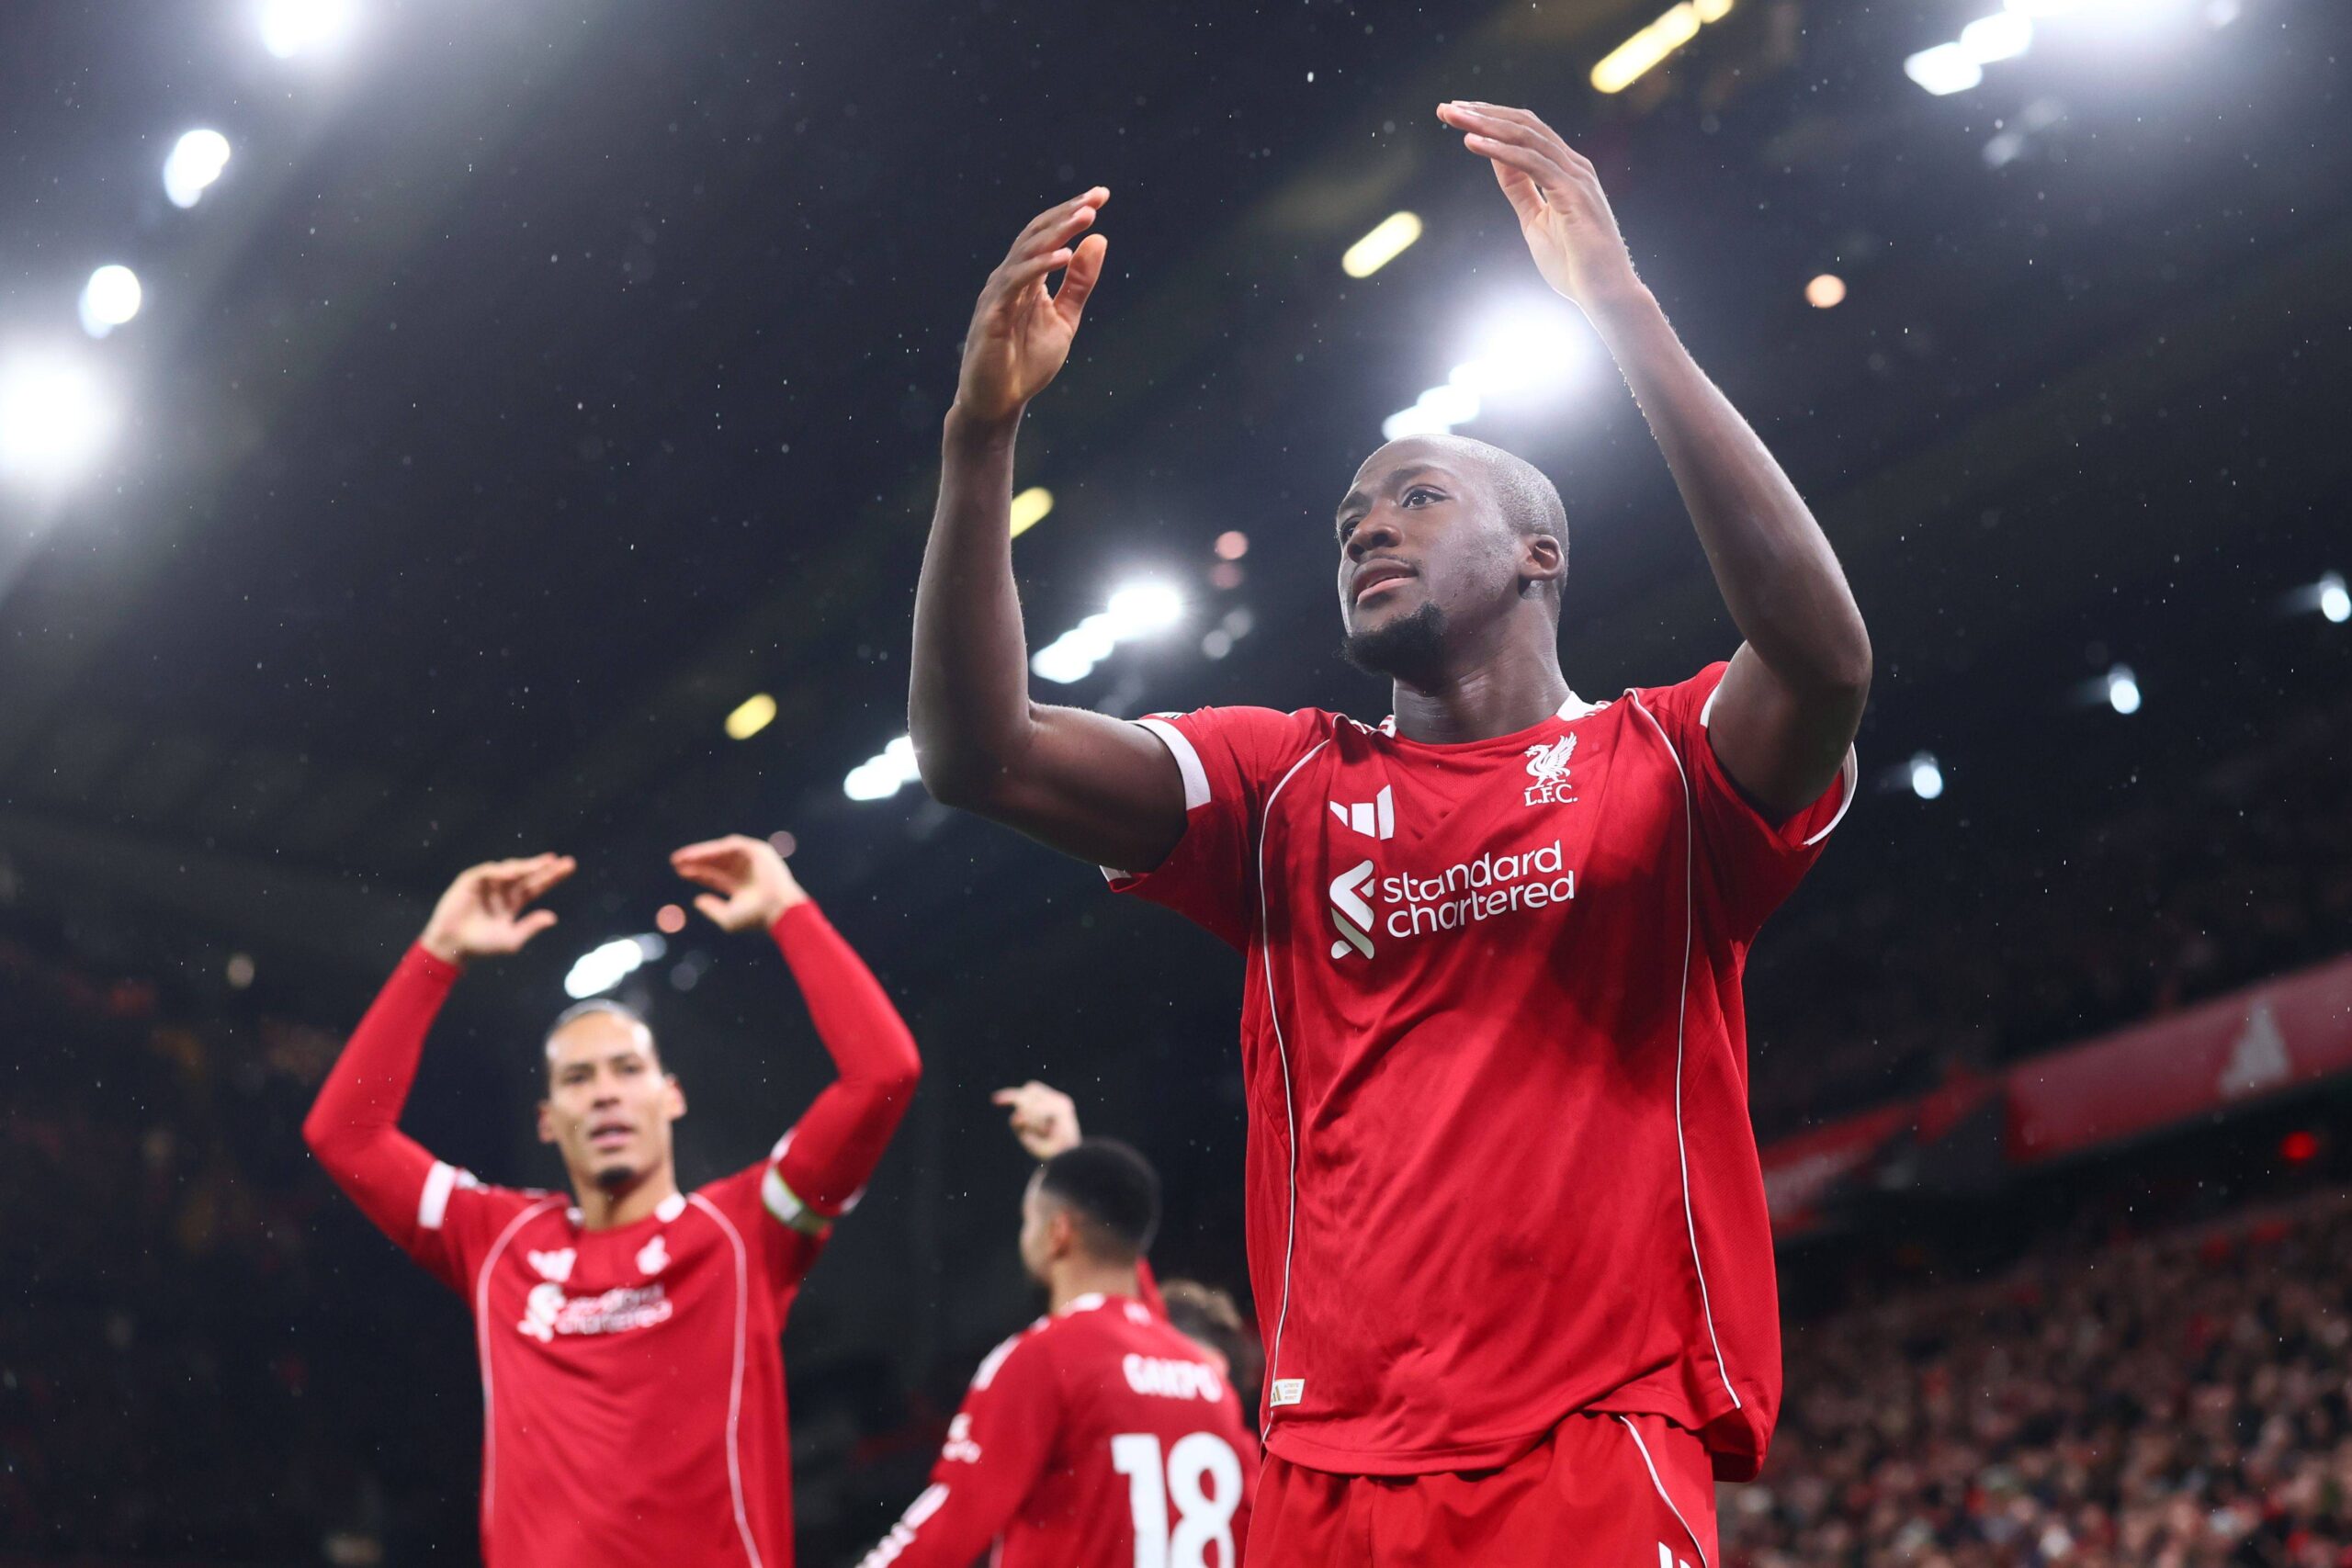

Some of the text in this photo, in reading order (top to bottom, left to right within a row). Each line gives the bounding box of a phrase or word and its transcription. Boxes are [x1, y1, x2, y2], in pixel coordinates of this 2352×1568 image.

[1523, 784, 1578, 807] L.F.C.
[1384, 840, 1563, 903] standard
[1387, 871, 1575, 938] chartered
[1111, 1432, 1243, 1568] 18
